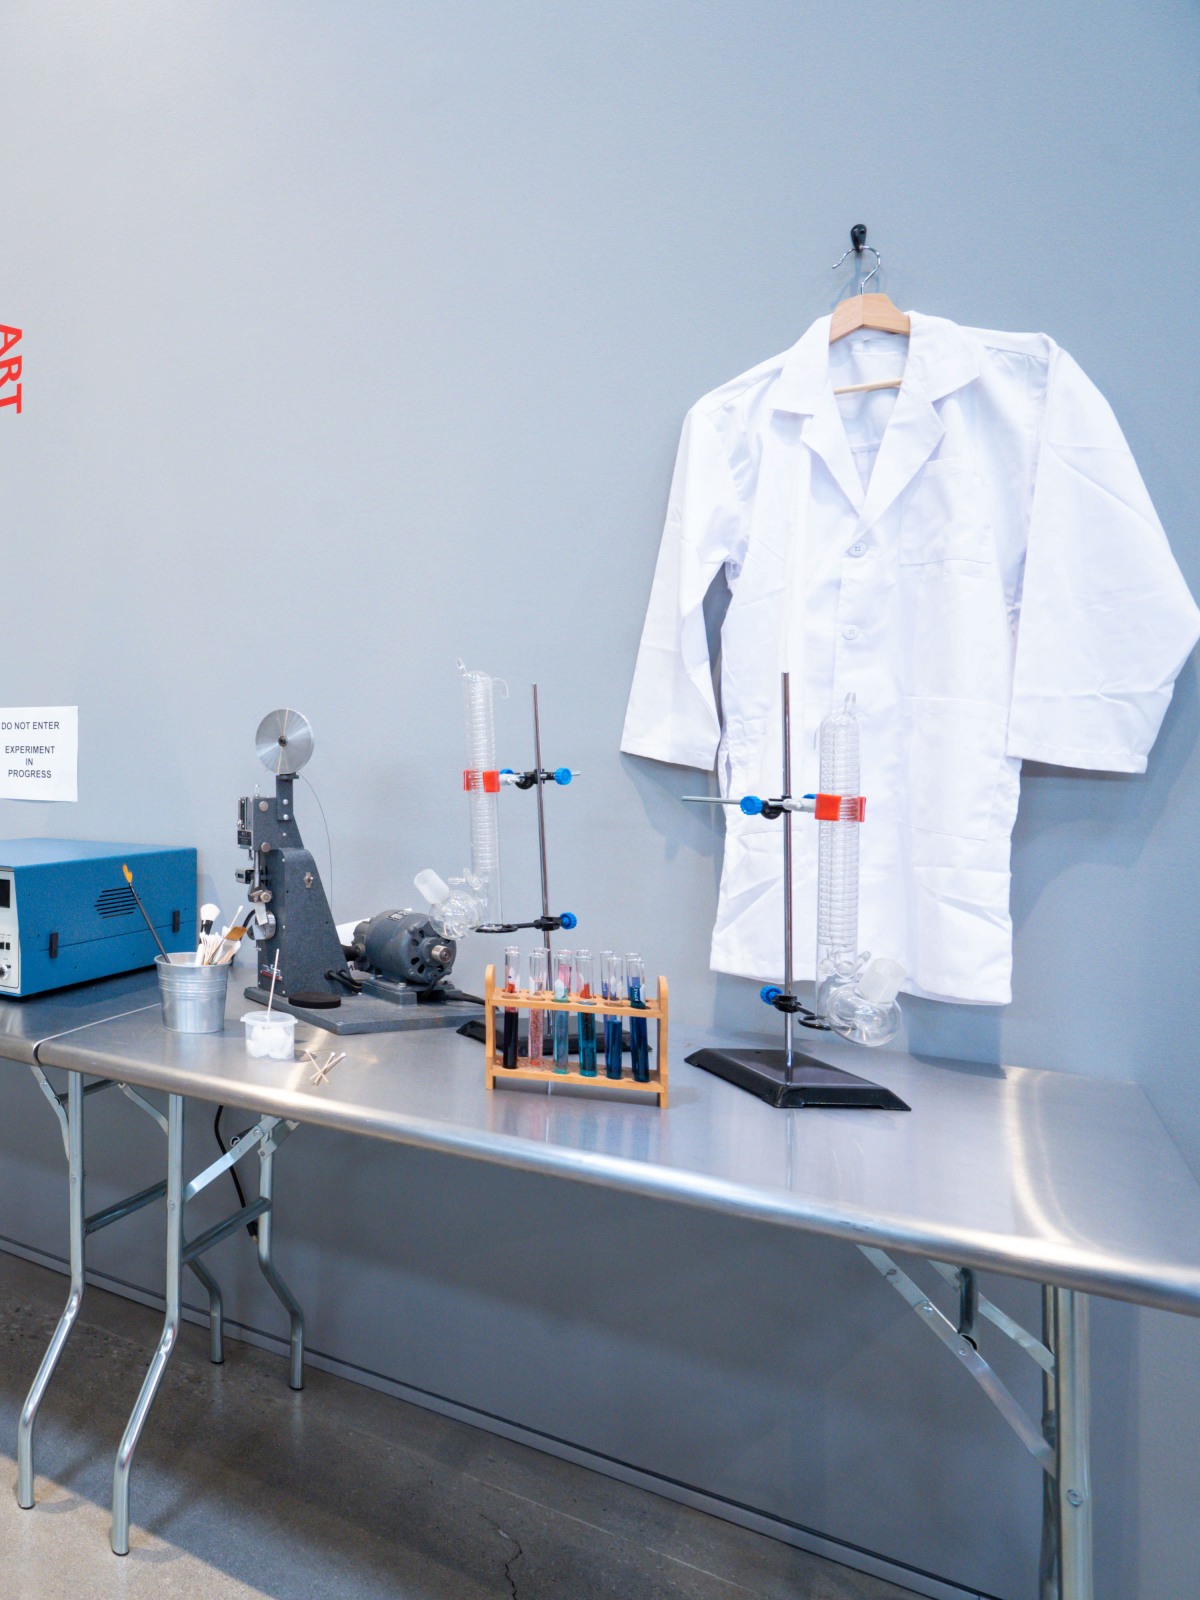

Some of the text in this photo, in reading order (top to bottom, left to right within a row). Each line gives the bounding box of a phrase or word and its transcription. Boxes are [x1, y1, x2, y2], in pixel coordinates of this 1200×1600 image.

[1, 721, 60, 730] DO NOT ENTER
[4, 745, 56, 755] EXPERIMENT
[25, 757, 34, 766] IN
[7, 769, 52, 779] PROGRESS
